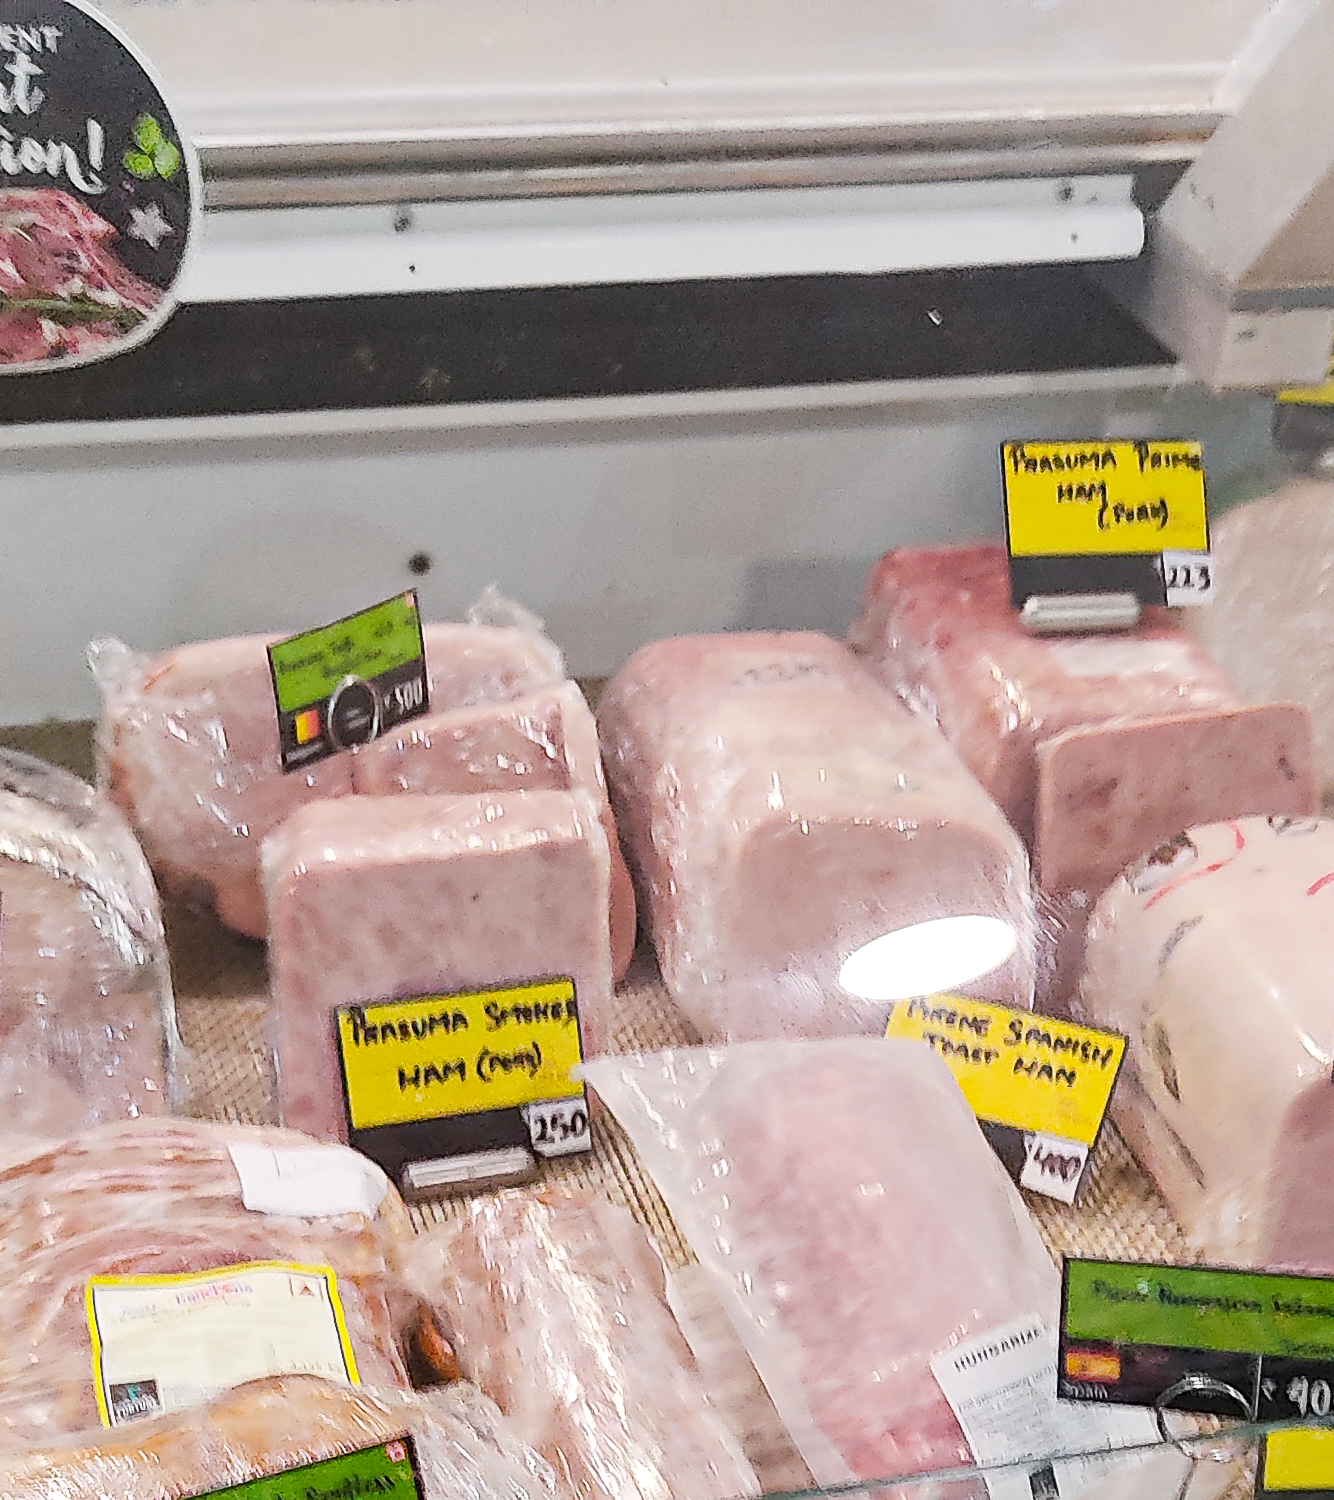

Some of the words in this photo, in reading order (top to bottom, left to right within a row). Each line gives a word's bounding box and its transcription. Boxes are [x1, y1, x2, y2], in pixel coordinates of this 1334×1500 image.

[349, 1004, 469, 1046] PRASUMA
[397, 1057, 466, 1093] HAM
[533, 1110, 587, 1142] 250
